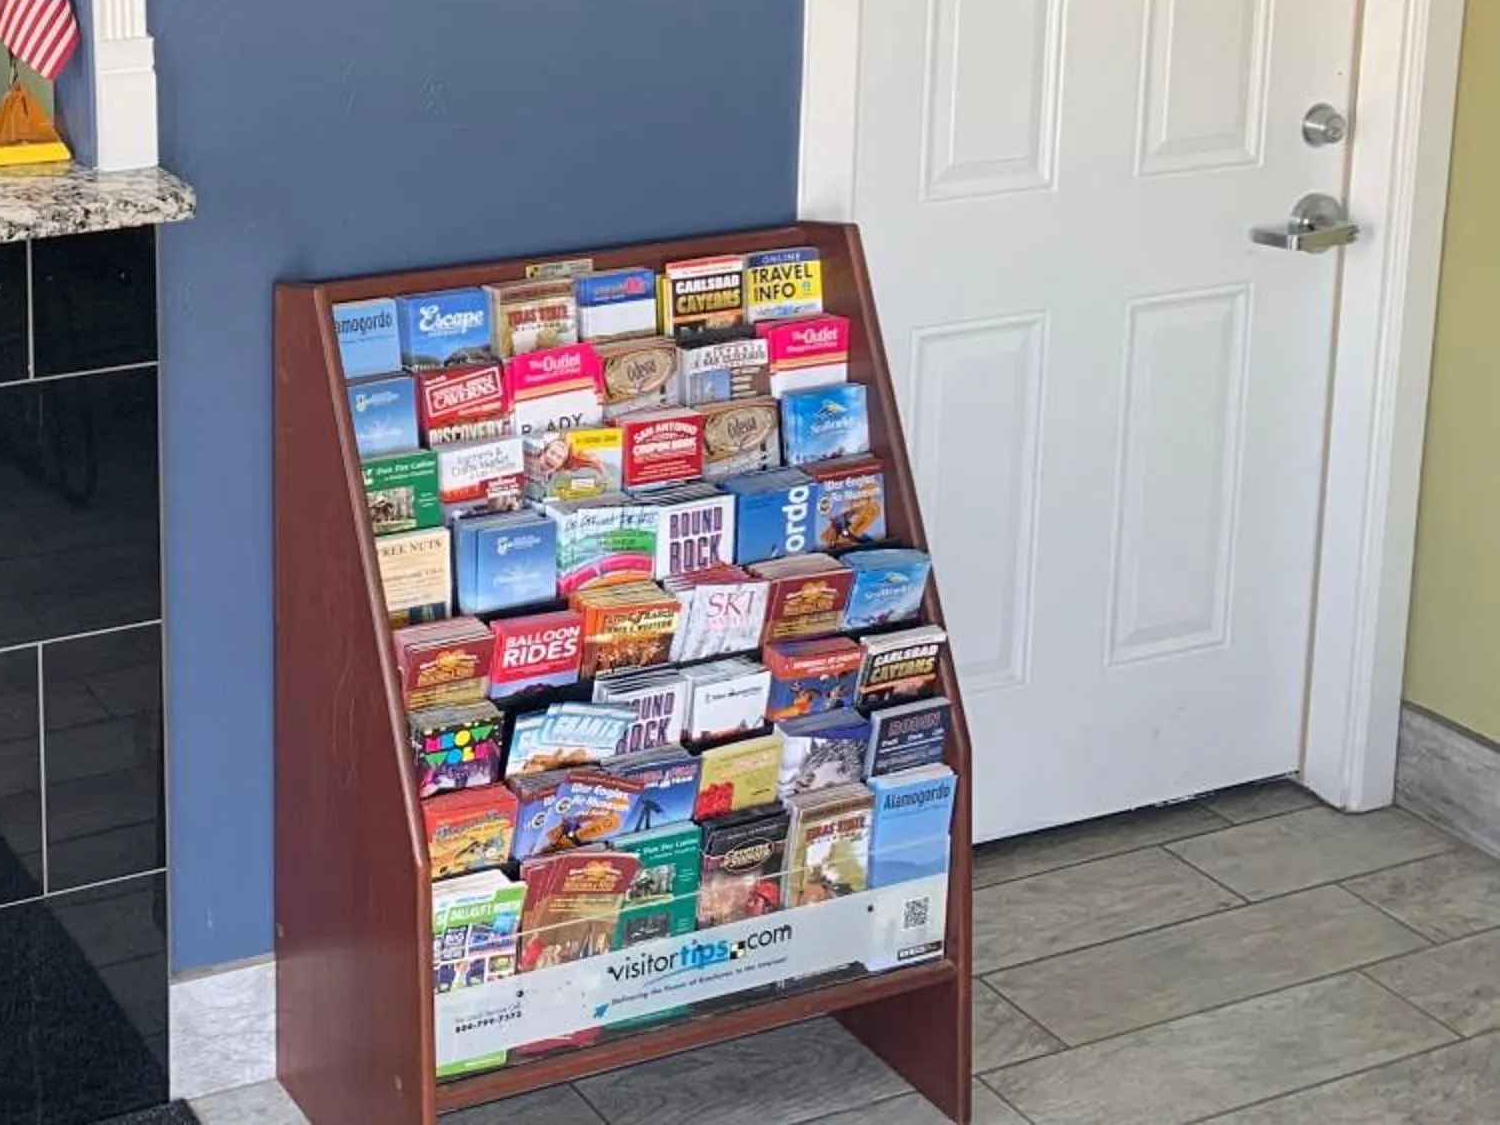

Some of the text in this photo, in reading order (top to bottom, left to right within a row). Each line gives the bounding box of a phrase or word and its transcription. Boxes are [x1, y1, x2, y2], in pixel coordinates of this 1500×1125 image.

[675, 275, 740, 294] CARLSBAD
[752, 265, 813, 285] TRAVEL
[675, 291, 741, 314] CAVERNS
[754, 282, 797, 303] INFO
[334, 309, 393, 336] amogordo
[419, 304, 485, 336] Escape
[543, 352, 582, 373] Outlet
[521, 412, 584, 435] RADY
[669, 506, 723, 540] ROUND
[669, 534, 723, 574] ROCK
[506, 625, 581, 648] BALLOON
[503, 638, 578, 668] RIDES
[873, 645, 939, 666] CARLSBAD
[869, 657, 936, 683] CAVERNS
[630, 692, 675, 721] OUND
[883, 783, 951, 811] Alamogordo
